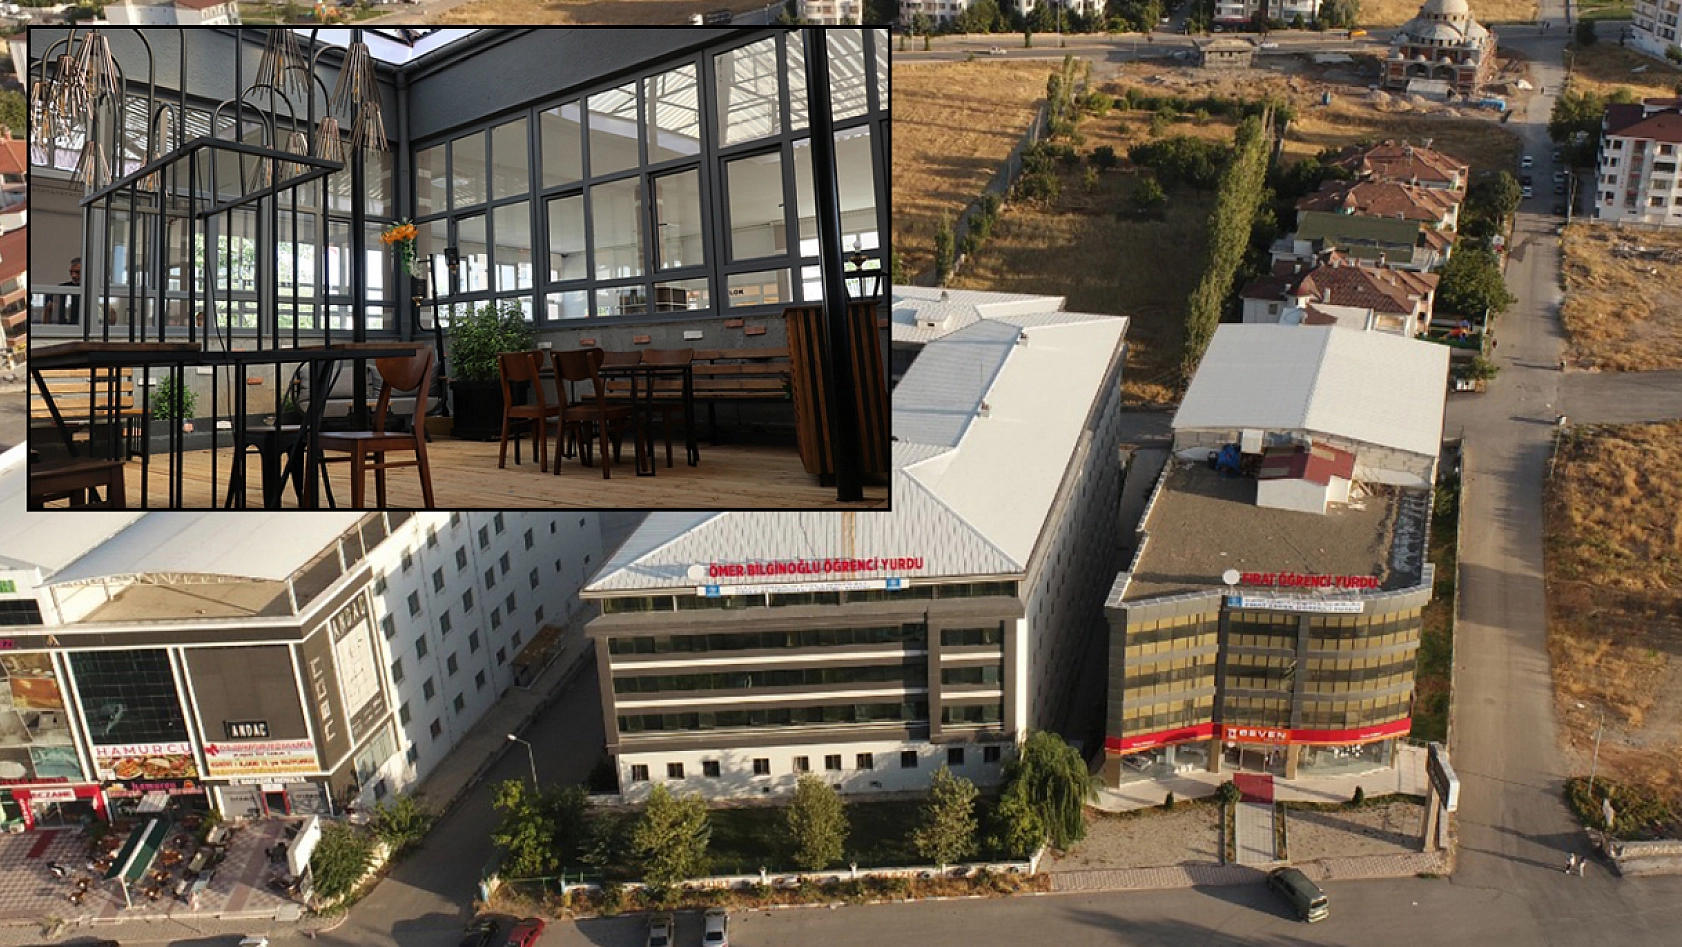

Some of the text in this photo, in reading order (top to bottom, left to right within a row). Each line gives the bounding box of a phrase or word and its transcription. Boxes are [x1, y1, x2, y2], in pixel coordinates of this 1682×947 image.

[709, 556, 924, 577] ÖMER BİLGİNOĞLU ÖĞRENCİ YURDU
[1241, 569, 1379, 589] FIRAT ÖĞRENCİ YURDU
[96, 743, 193, 756] HAMURCU
